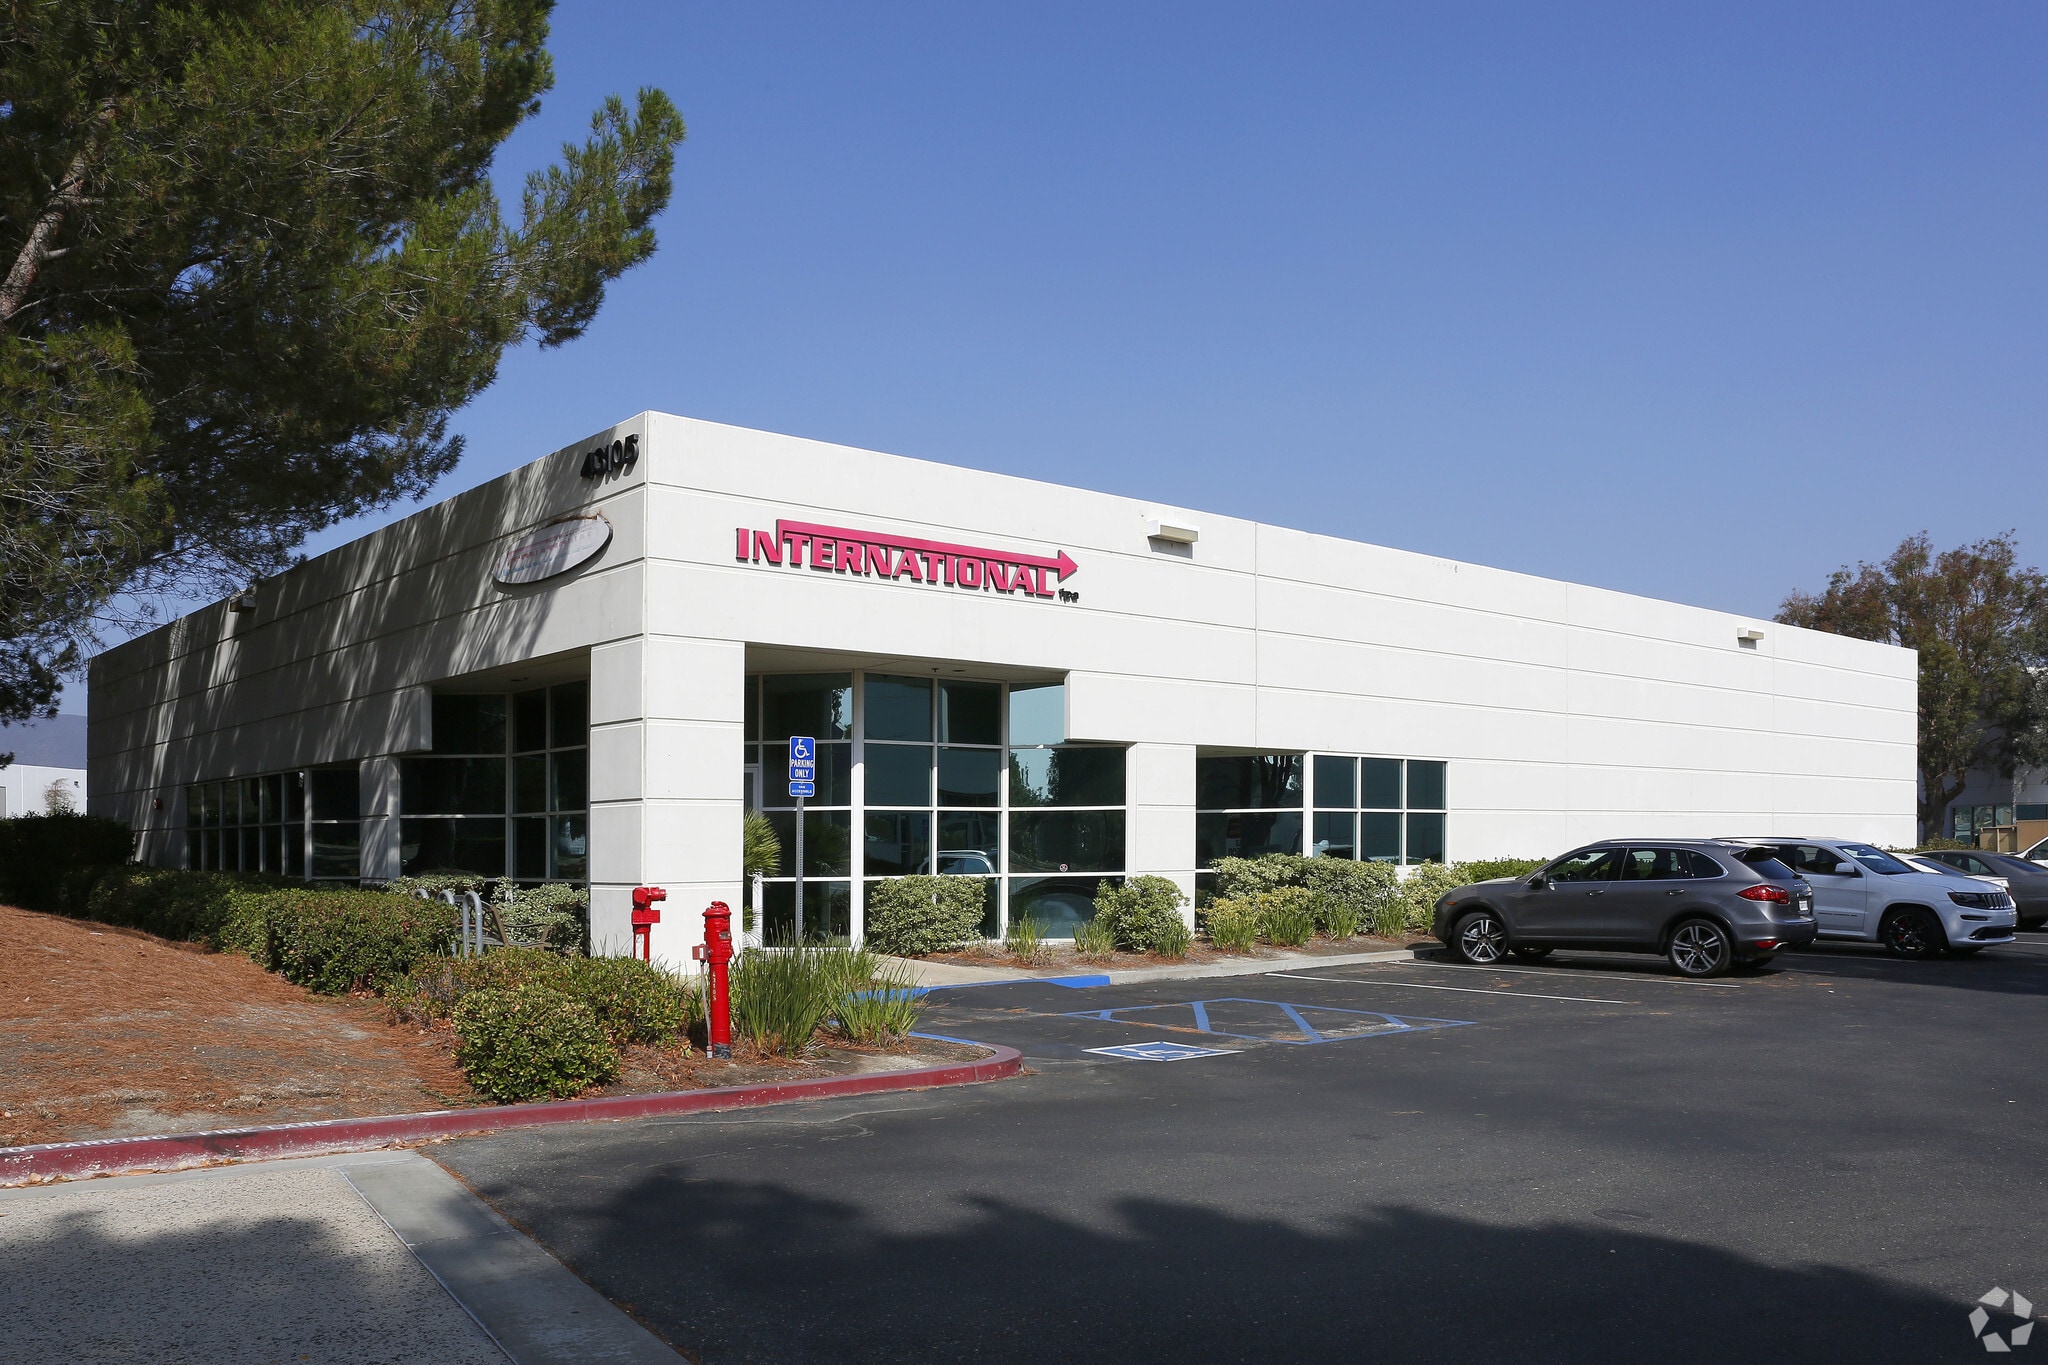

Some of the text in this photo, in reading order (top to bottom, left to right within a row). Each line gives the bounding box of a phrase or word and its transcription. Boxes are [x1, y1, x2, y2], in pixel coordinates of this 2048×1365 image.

[580, 433, 640, 479] 43105
[734, 526, 1056, 598] INTERNATIONAL
[791, 759, 814, 768] PARKING
[794, 769, 809, 777] ONLY
[45, 1134, 170, 1150] PARKING
